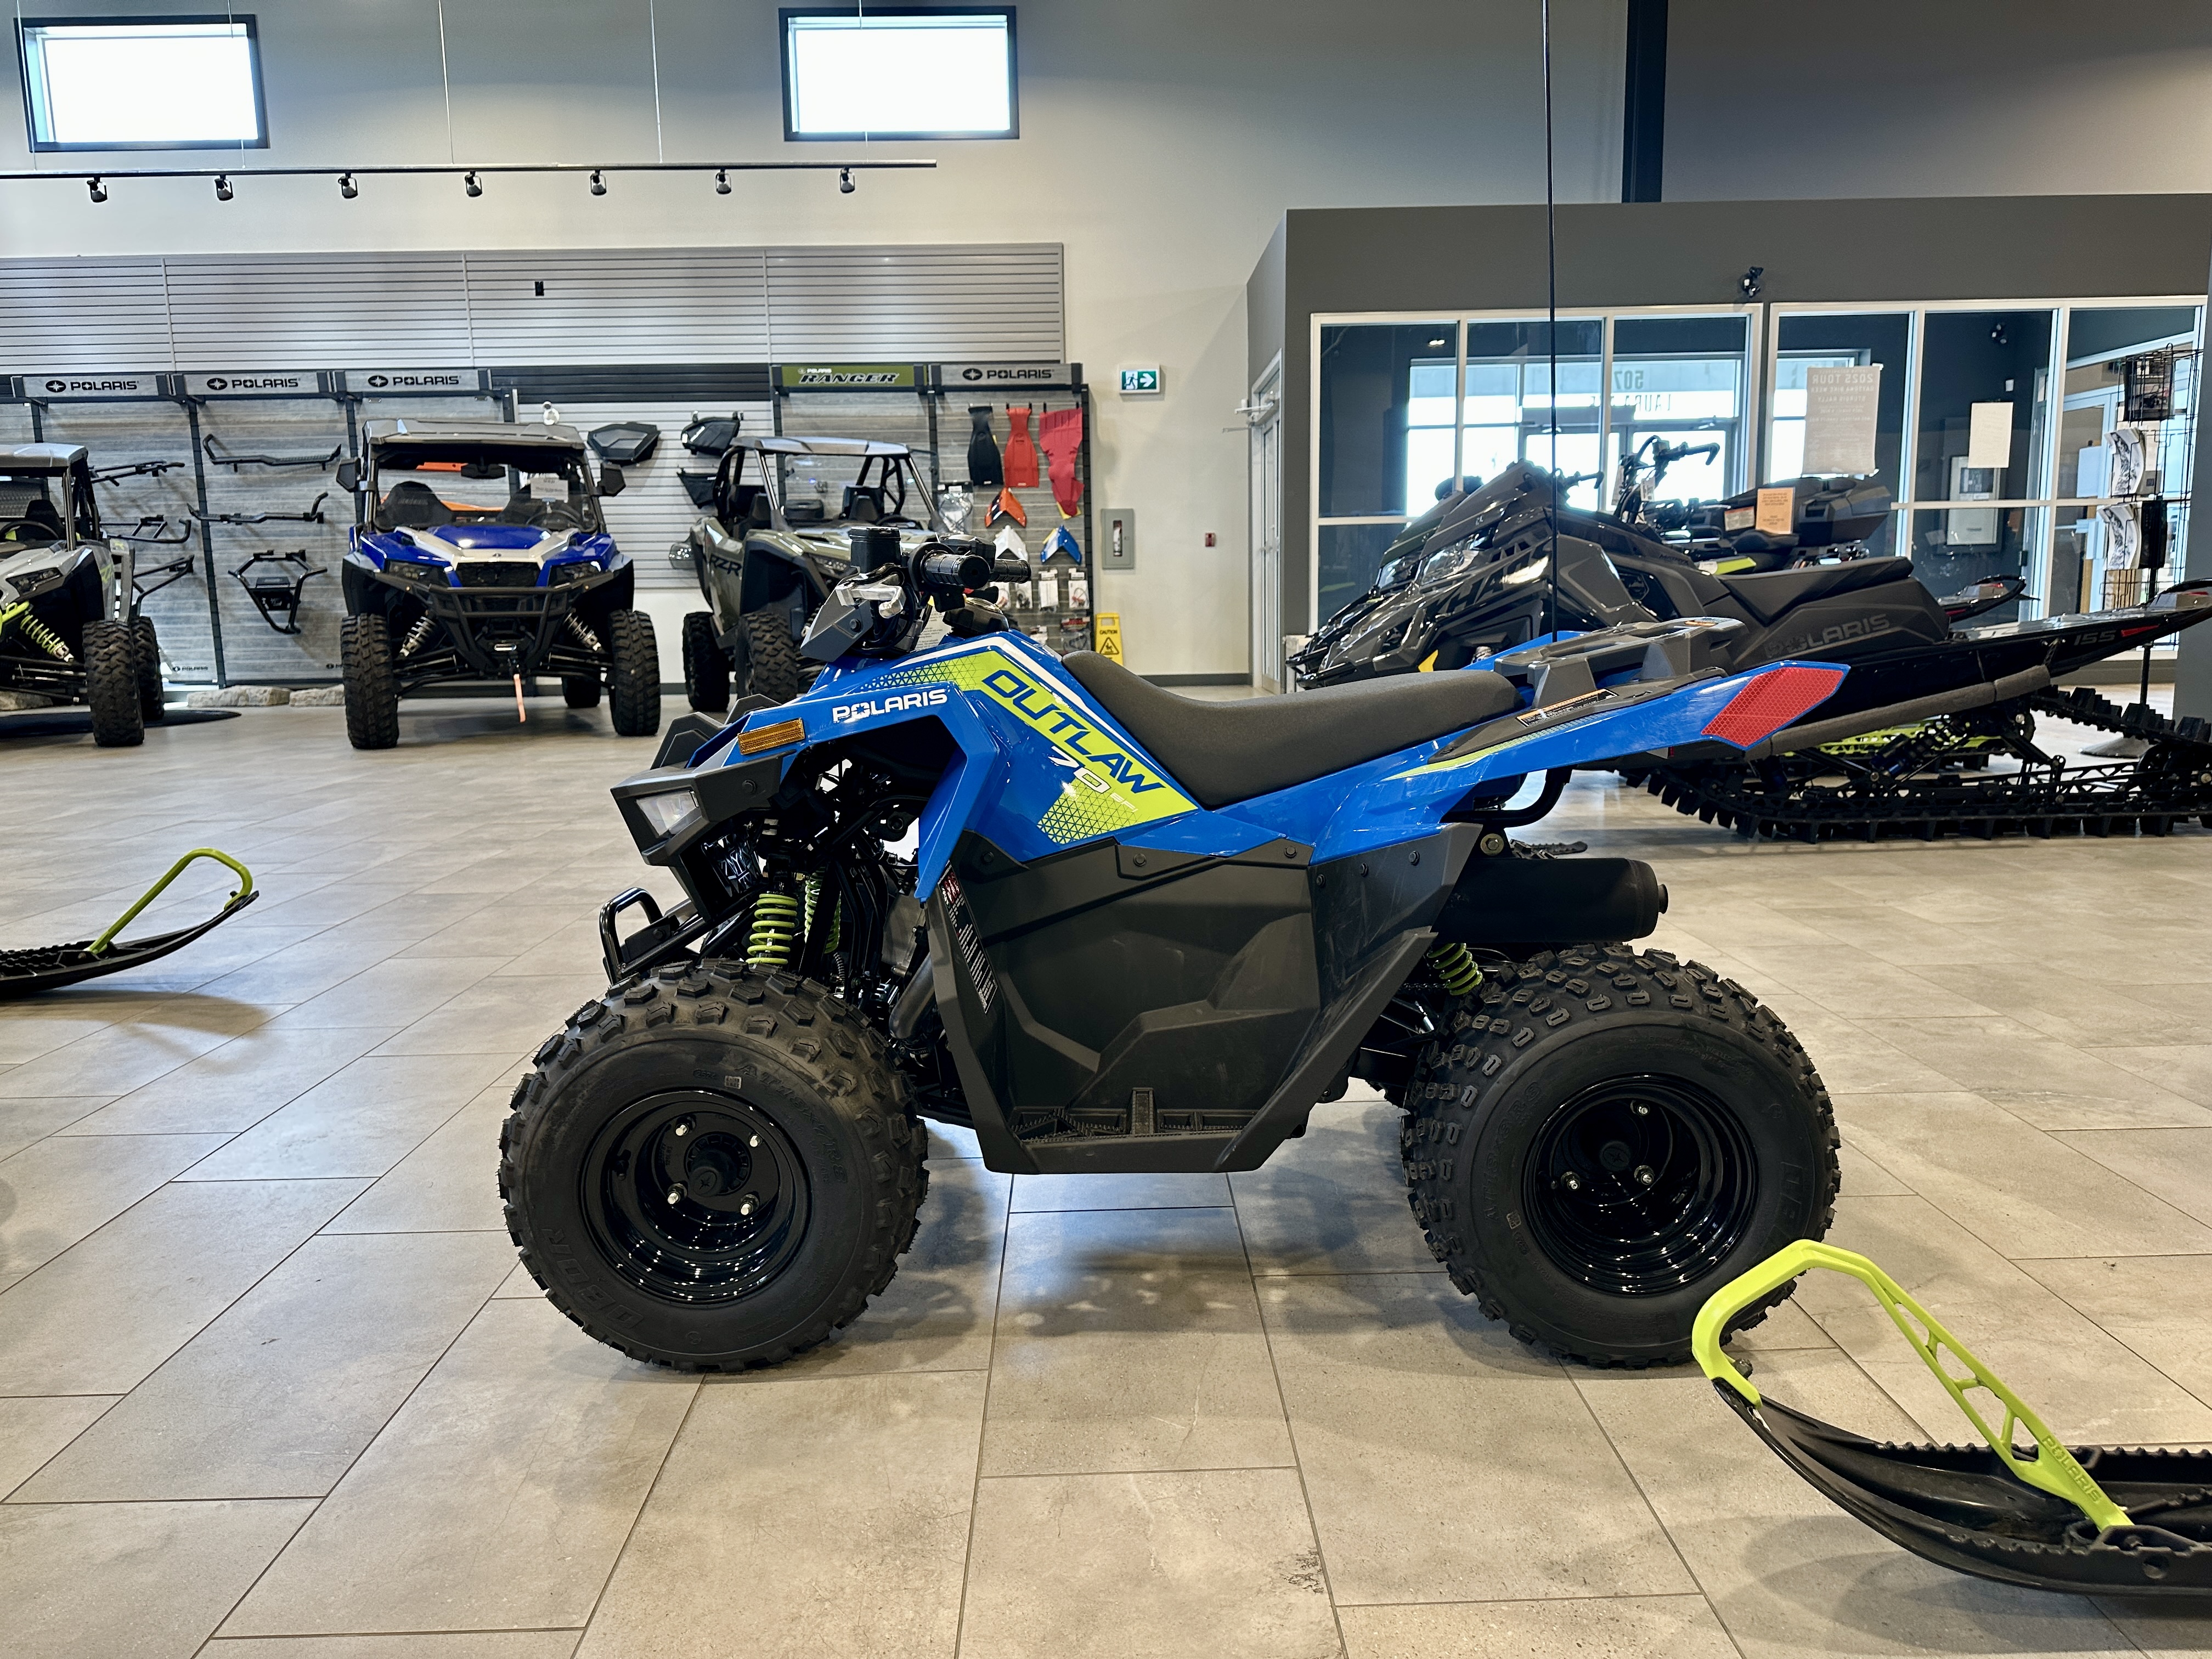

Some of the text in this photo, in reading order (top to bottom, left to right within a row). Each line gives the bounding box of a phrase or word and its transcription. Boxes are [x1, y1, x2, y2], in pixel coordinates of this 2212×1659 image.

[231, 378, 299, 389] POLARIS
[392, 375, 460, 386] POLARIS
[799, 373, 899, 383] RANGER
[986, 369, 1052, 379] POLARIS
[70, 380, 138, 391] POLARIS
[709, 554, 742, 577] RZR
[1764, 613, 1891, 659] POLARIS
[2074, 630, 2116, 646] 155
[832, 689, 949, 723] POLARIS
[981, 668, 1166, 794] OUTLAW
[1047, 745, 1111, 794] 70
[1109, 792, 1139, 813] EFI
[2041, 1435, 2102, 1503] POLARIS
